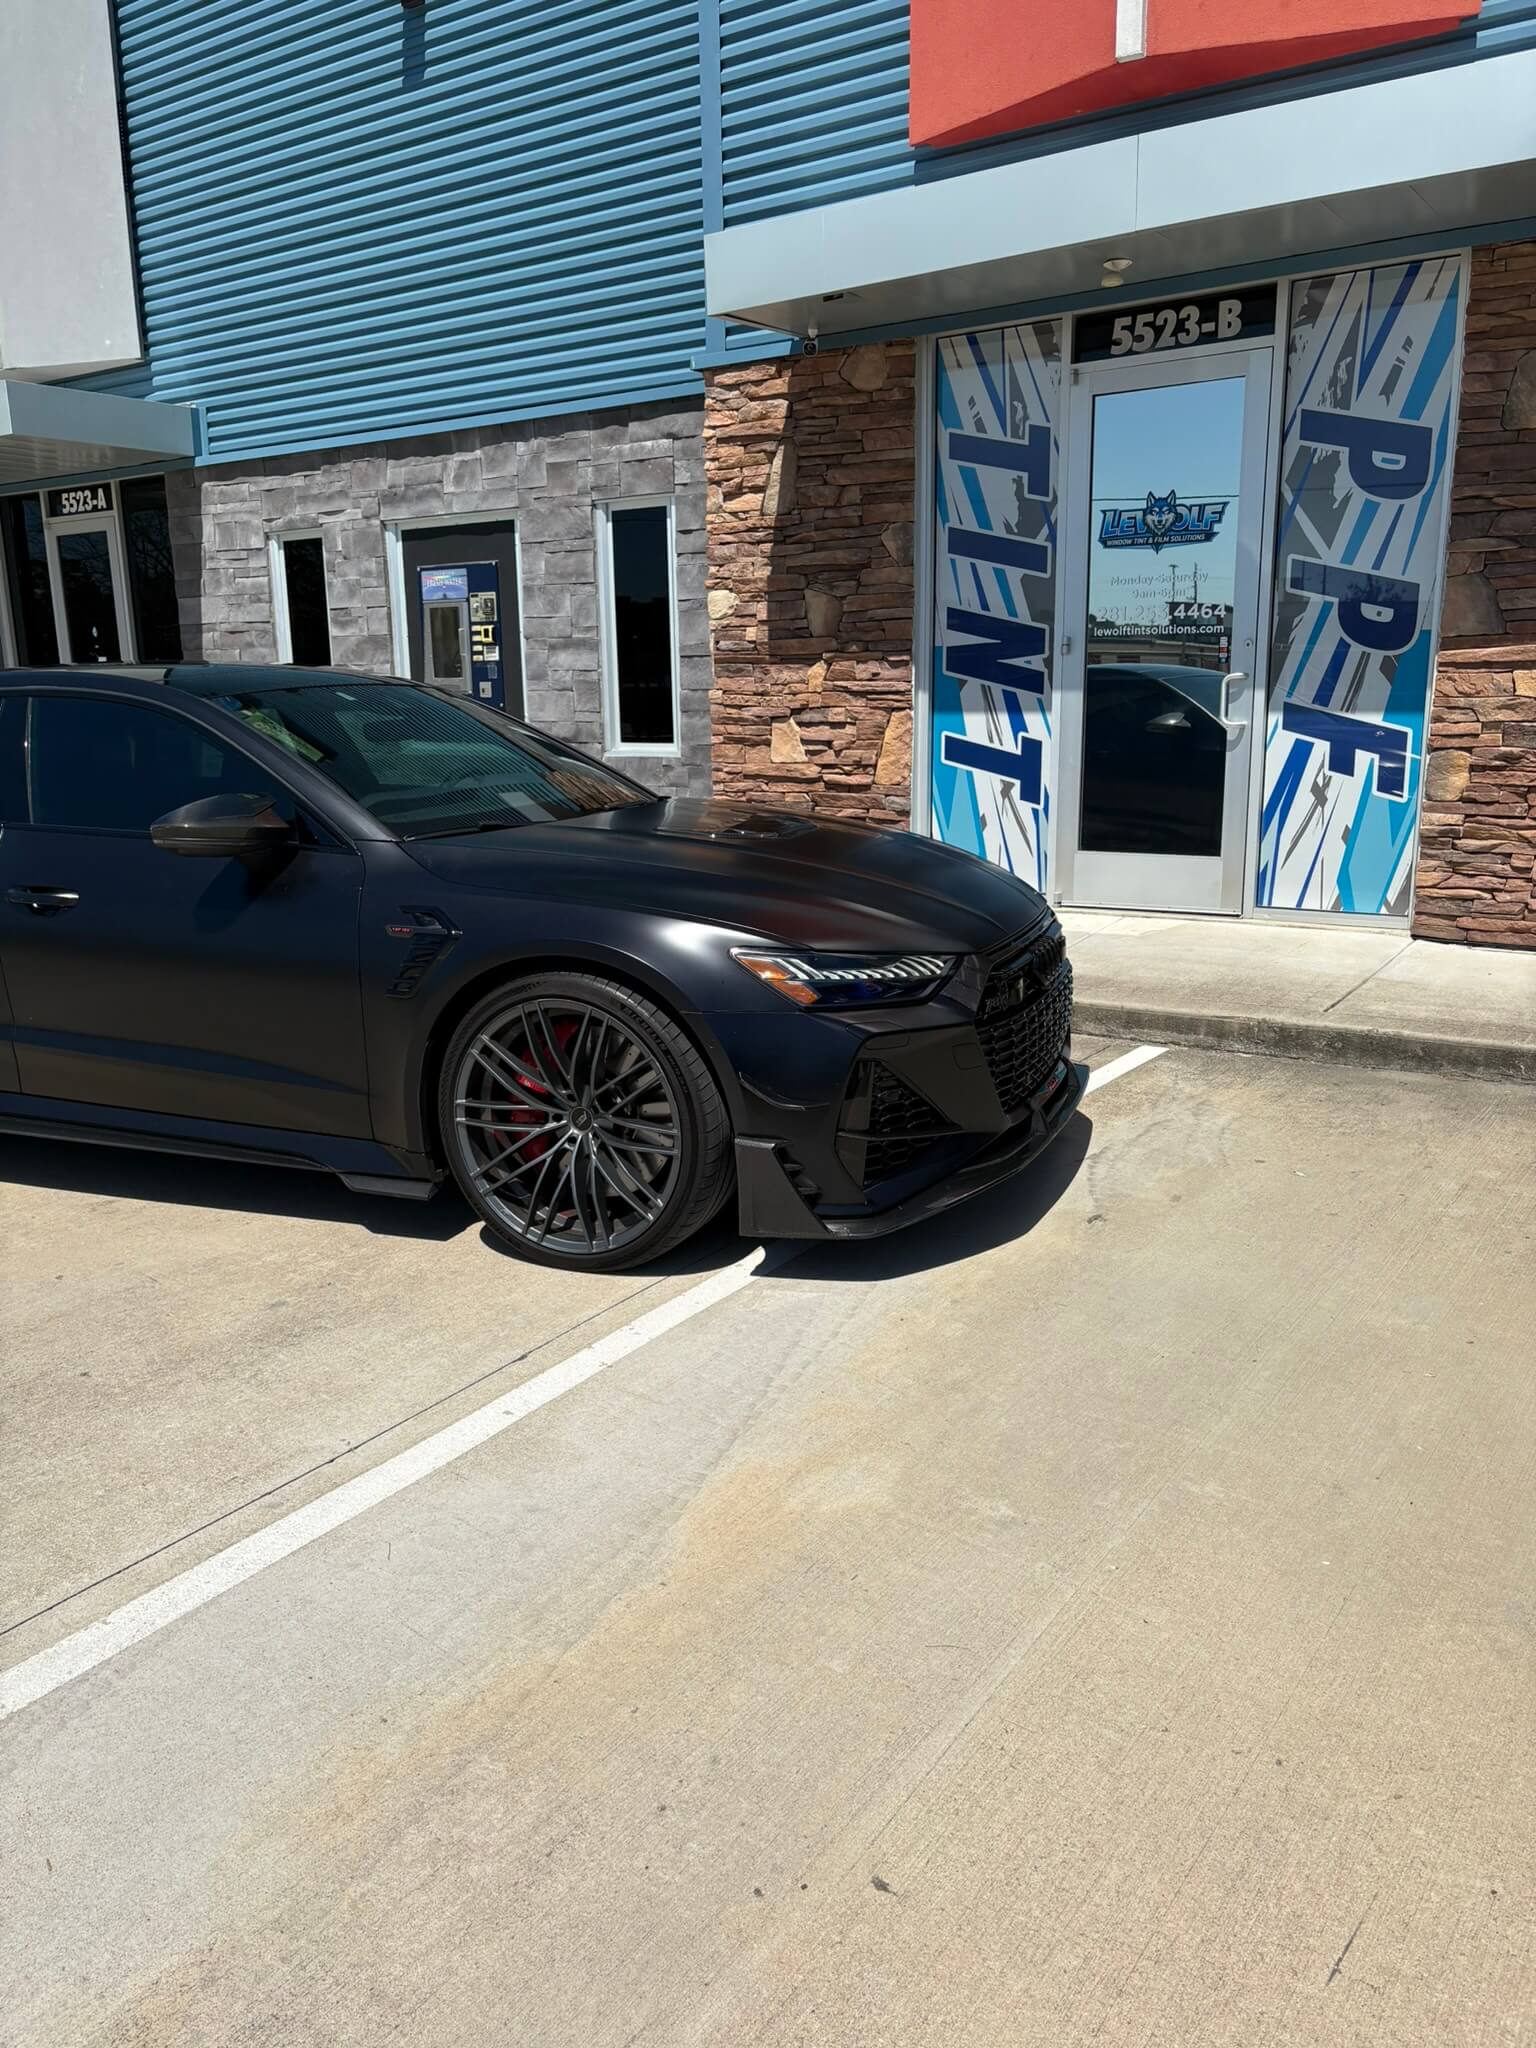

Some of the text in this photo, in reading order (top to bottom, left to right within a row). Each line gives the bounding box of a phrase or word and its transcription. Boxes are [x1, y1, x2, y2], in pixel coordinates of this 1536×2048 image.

[1110, 299, 1243, 356] 5523-B
[62, 488, 107, 514] 5523-A
[1102, 503, 1224, 538] LEOLF
[1106, 538, 1132, 546] WINDOW
[1170, 533, 1206, 543] SOLUTIONS
[943, 423, 1051, 806] TINT
[1282, 408, 1433, 799] PPF
[1094, 623, 1225, 637] lewolftintsolutions.com
